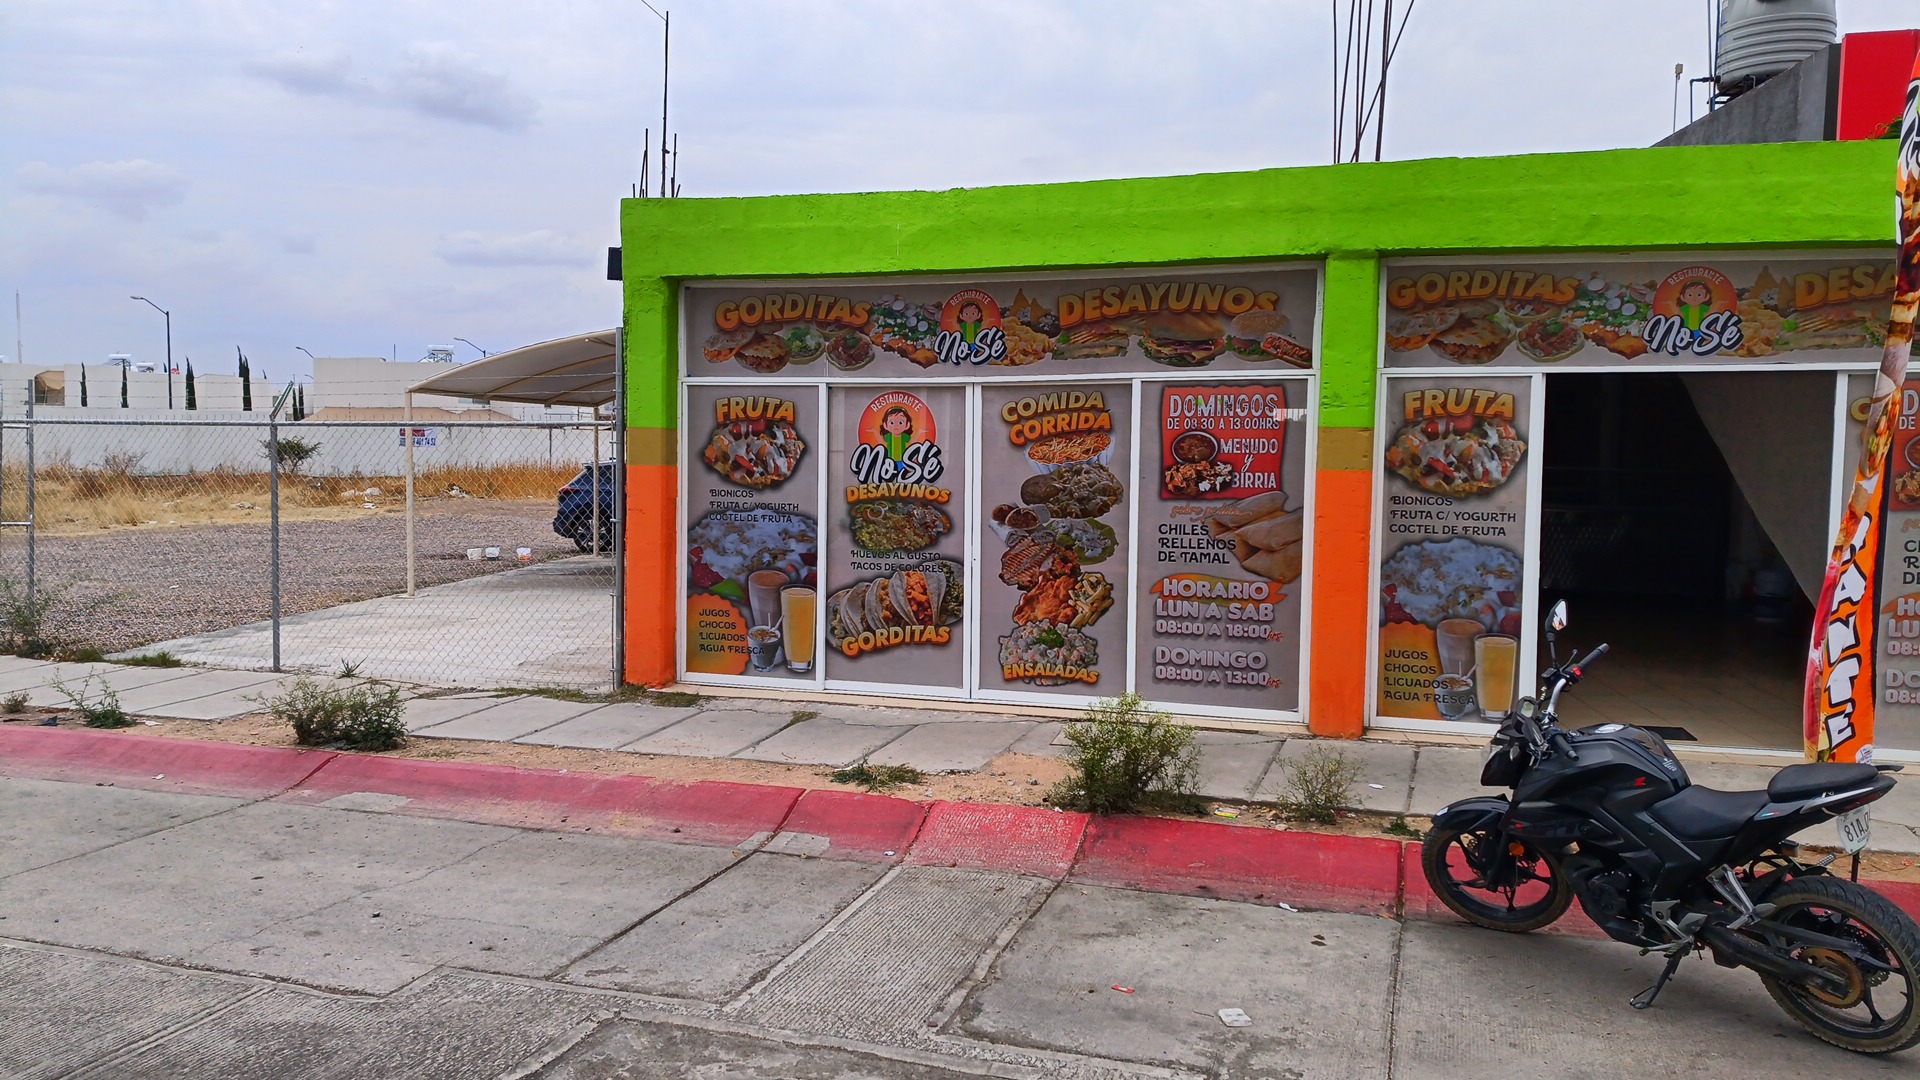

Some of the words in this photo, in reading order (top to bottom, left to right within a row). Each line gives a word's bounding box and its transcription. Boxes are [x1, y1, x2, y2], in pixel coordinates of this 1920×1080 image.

[1667, 267, 1724, 286] RESTAURANTE
[1387, 269, 1580, 310] GORDITAS
[949, 290, 991, 306] RESTAURANTE
[1057, 282, 1280, 329] DESAYUNOS
[715, 293, 872, 331] GORDITAS
[1642, 314, 1693, 356] No
[1692, 310, 1744, 356] Sé
[934, 330, 970, 365] No
[970, 326, 1007, 365] Sé
[715, 396, 796, 424] FRUTA
[870, 393, 922, 413] RESTAURANTE
[1001, 391, 1104, 424] COMIDA
[1169, 394, 1278, 417] DOMINGOS
[1404, 388, 1515, 421] FRUTA
[1009, 411, 1112, 446] CORRIDA
[1167, 418, 1180, 430] DE
[1184, 418, 1215, 429] 08:30
[1219, 418, 1225, 429] A
[1220, 439, 1279, 454] MENUDO
[850, 443, 897, 485] No
[897, 439, 944, 485] Sé
[1231, 472, 1277, 488] BIRRIA
[709, 489, 754, 498] BIONICOS
[846, 482, 952, 504] DESAYUNOS
[1390, 496, 1453, 506] BIONICOS
[709, 500, 740, 510] FRUTA
[754, 502, 799, 511] YOGURTH
[709, 513, 744, 522] COCTEL
[747, 514, 759, 522] DE
[761, 514, 792, 523] FRUTA
[1390, 510, 1433, 520] FRUTA
[1436, 511, 1450, 520] C/
[1453, 511, 1516, 523] YOGURTH
[1158, 524, 1209, 536] CHILES
[1389, 524, 1439, 534] COCTEL
[1442, 525, 1458, 535] DE
[1462, 526, 1506, 536] FRUTA
[1158, 537, 1236, 550] RELLENOS
[850, 549, 891, 559] HUEVOS
[893, 551, 905, 560] AL
[907, 552, 940, 560] GUSTO
[1158, 551, 1176, 562] DE
[1180, 552, 1230, 564] TAMAL
[850, 561, 882, 571] TACOS
[884, 563, 898, 571] DE
[899, 564, 944, 573] COLORES
[1163, 578, 1269, 600] HORARIO
[699, 609, 730, 617] JUGOS
[1156, 598, 1199, 618] LUN
[1205, 602, 1222, 619] A
[1228, 603, 1274, 621] SAB
[699, 620, 737, 629] CHOCOS
[1156, 619, 1204, 635] 08:00
[1208, 623, 1221, 636] A
[1226, 624, 1272, 638] 18:00
[699, 632, 745, 641] LICUADOS
[841, 625, 951, 658] GORDITAS
[699, 644, 725, 653] AGUA
[728, 645, 765, 655] FRESCA
[1385, 649, 1428, 660] JUGOS
[1155, 646, 1267, 670] DOMINGO
[1003, 662, 1100, 685] ENSALADAS
[1155, 665, 1203, 681] 08:00
[1208, 670, 1220, 682] A
[1225, 670, 1271, 686] 13:00
[1384, 663, 1437, 674] CHOCOS
[1384, 677, 1449, 689] LICUADOS
[1384, 690, 1420, 701] AGUA
[1423, 693, 1475, 706] FRESCA
